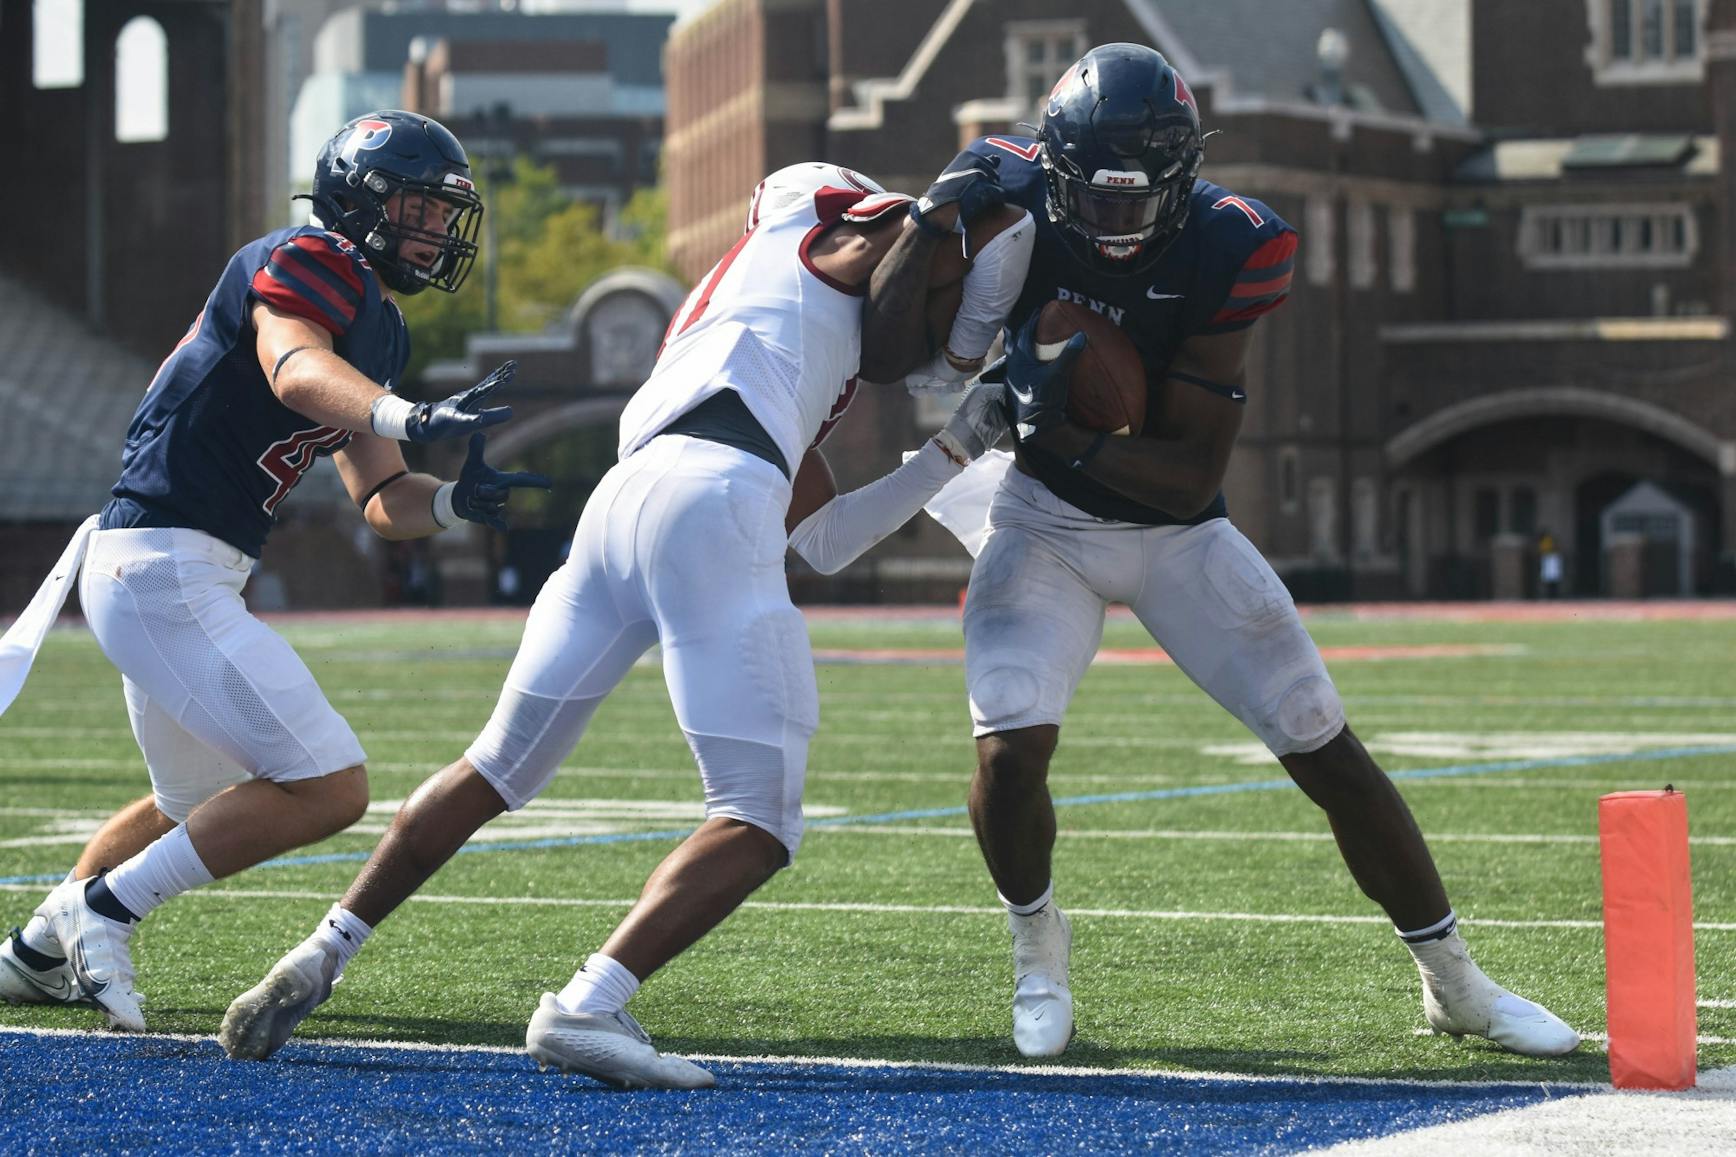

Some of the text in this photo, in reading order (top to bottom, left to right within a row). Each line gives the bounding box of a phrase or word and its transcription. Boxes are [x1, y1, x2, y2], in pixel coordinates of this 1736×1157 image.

[1106, 175, 1136, 185] PENN
[1211, 195, 1265, 229] 7
[1057, 286, 1126, 326] PENN
